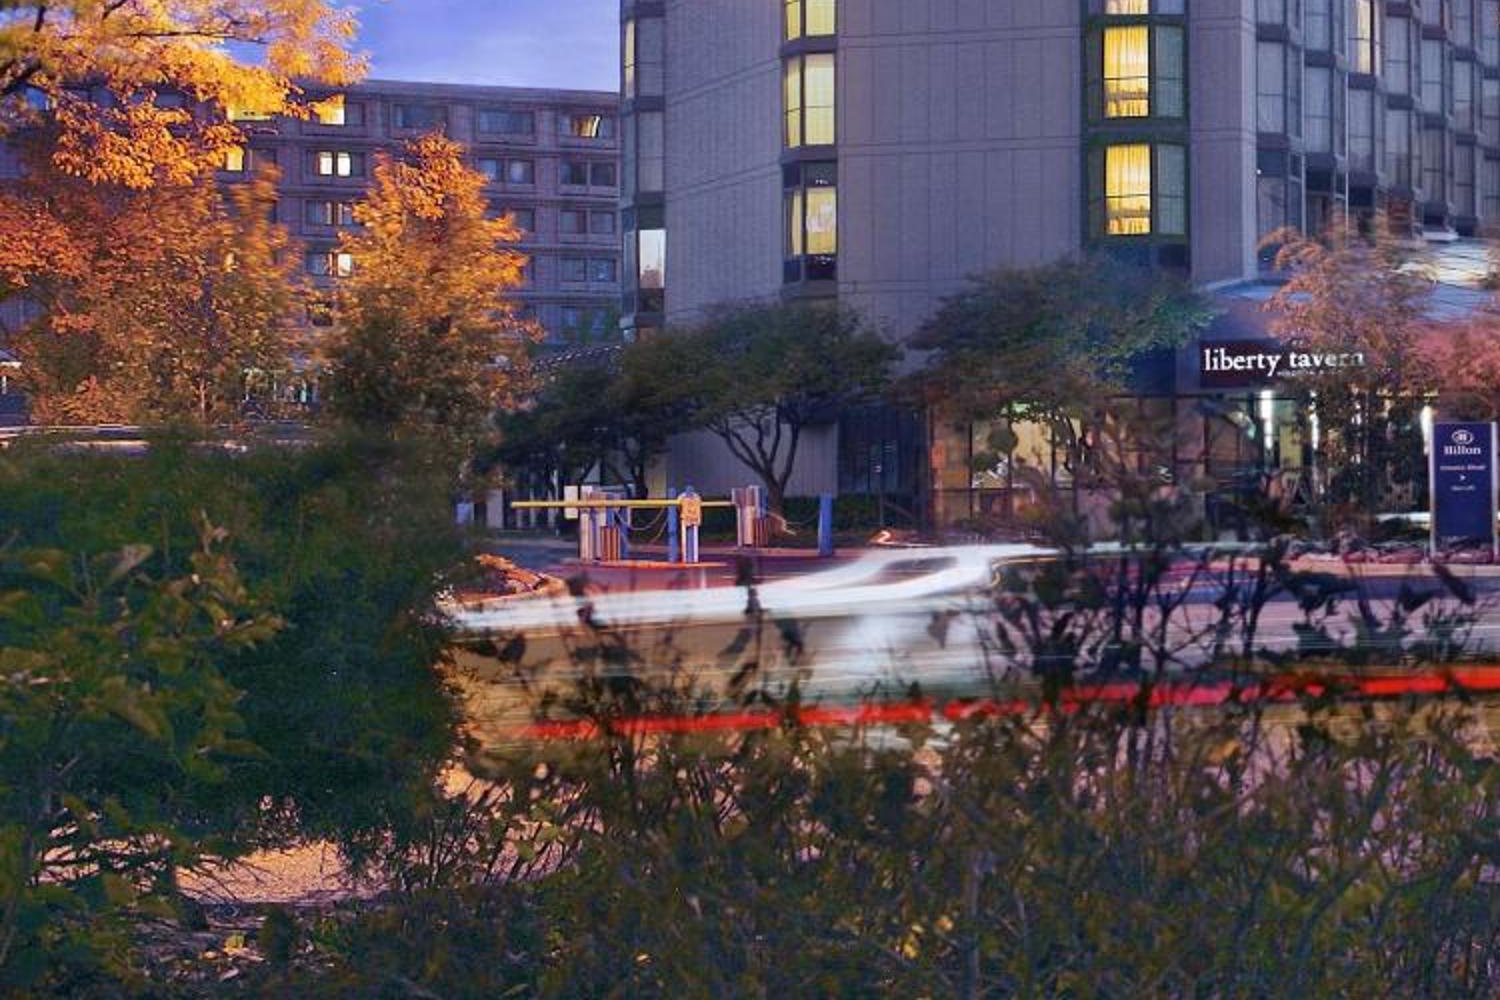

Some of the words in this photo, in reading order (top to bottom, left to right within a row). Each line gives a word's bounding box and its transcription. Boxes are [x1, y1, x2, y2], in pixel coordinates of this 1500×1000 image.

[1204, 348, 1281, 376] liberty
[1289, 351, 1366, 368] tavern
[1443, 445, 1481, 455] Hilton
